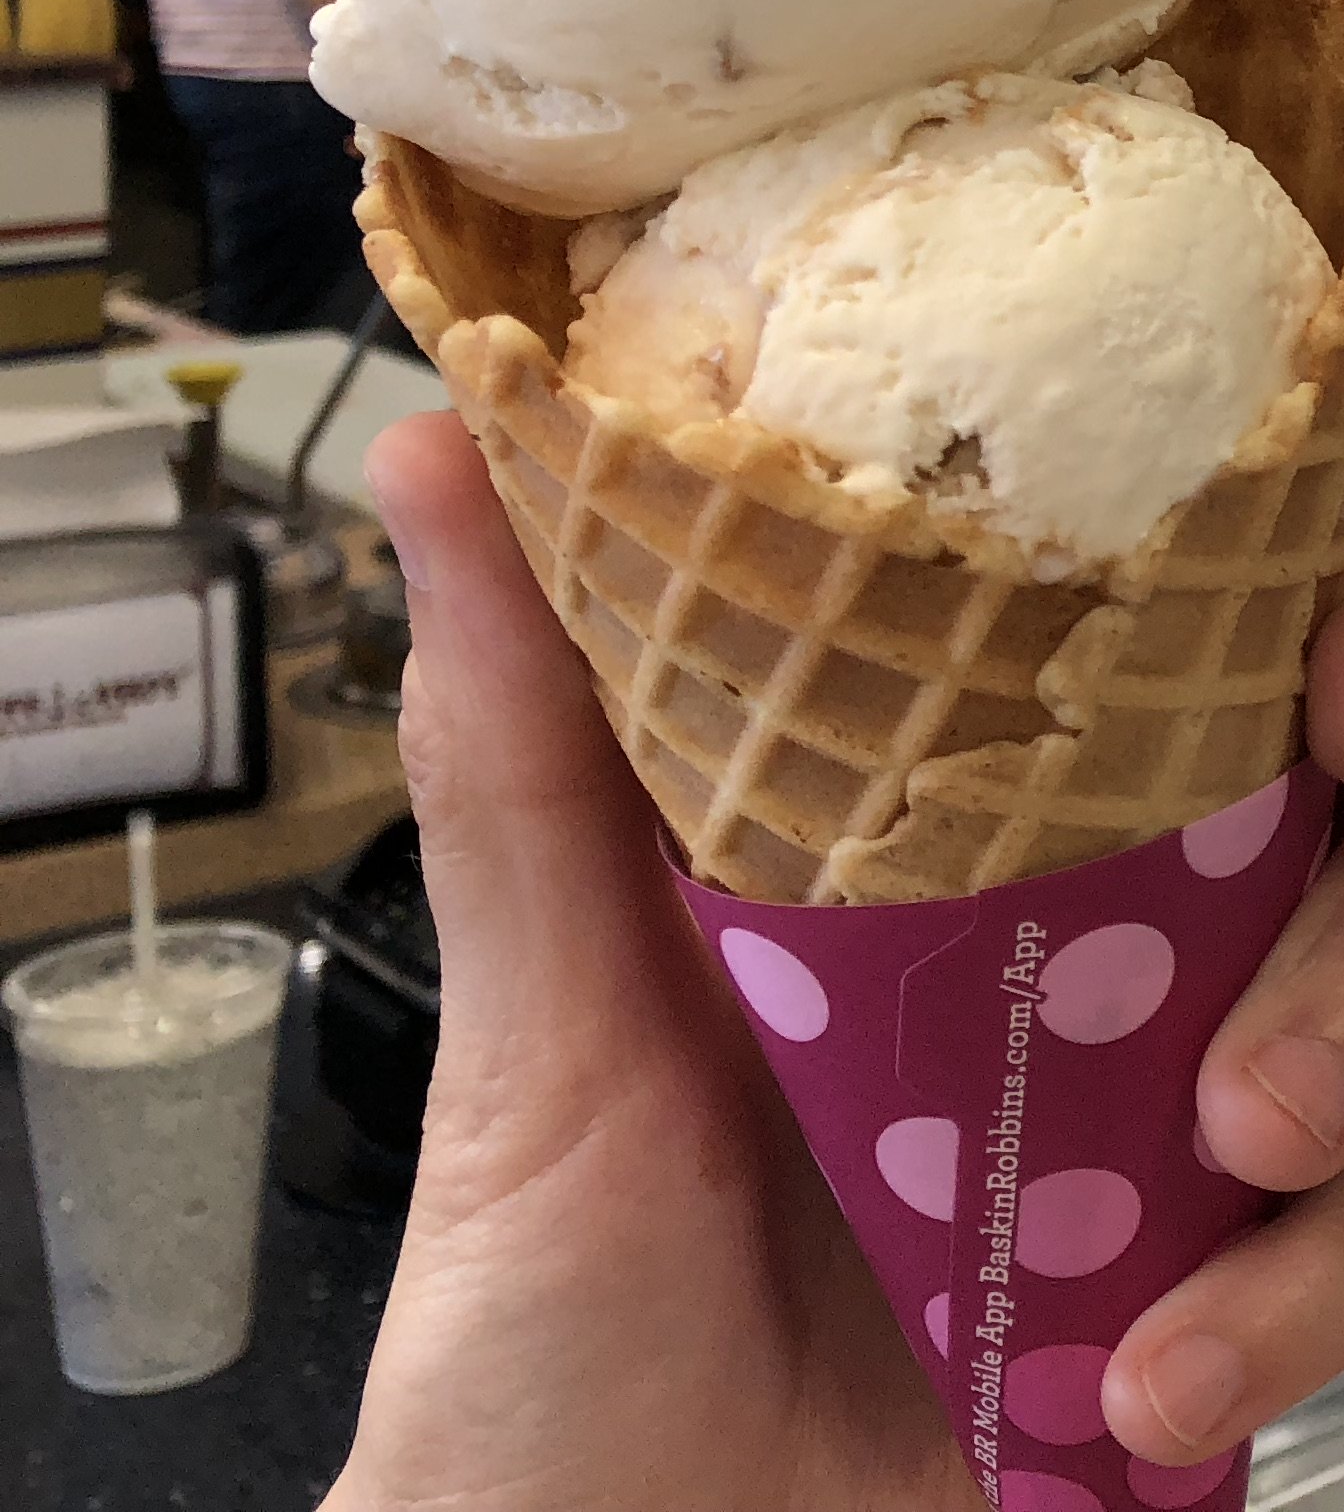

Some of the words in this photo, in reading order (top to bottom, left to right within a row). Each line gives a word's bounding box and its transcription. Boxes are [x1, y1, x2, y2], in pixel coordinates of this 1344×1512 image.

[979, 921, 1047, 1284] BaskinRobbins.com/App
[976, 1291, 1014, 1346] App
[971, 1350, 1003, 1435] Mobile
[974, 1434, 998, 1471] BR
